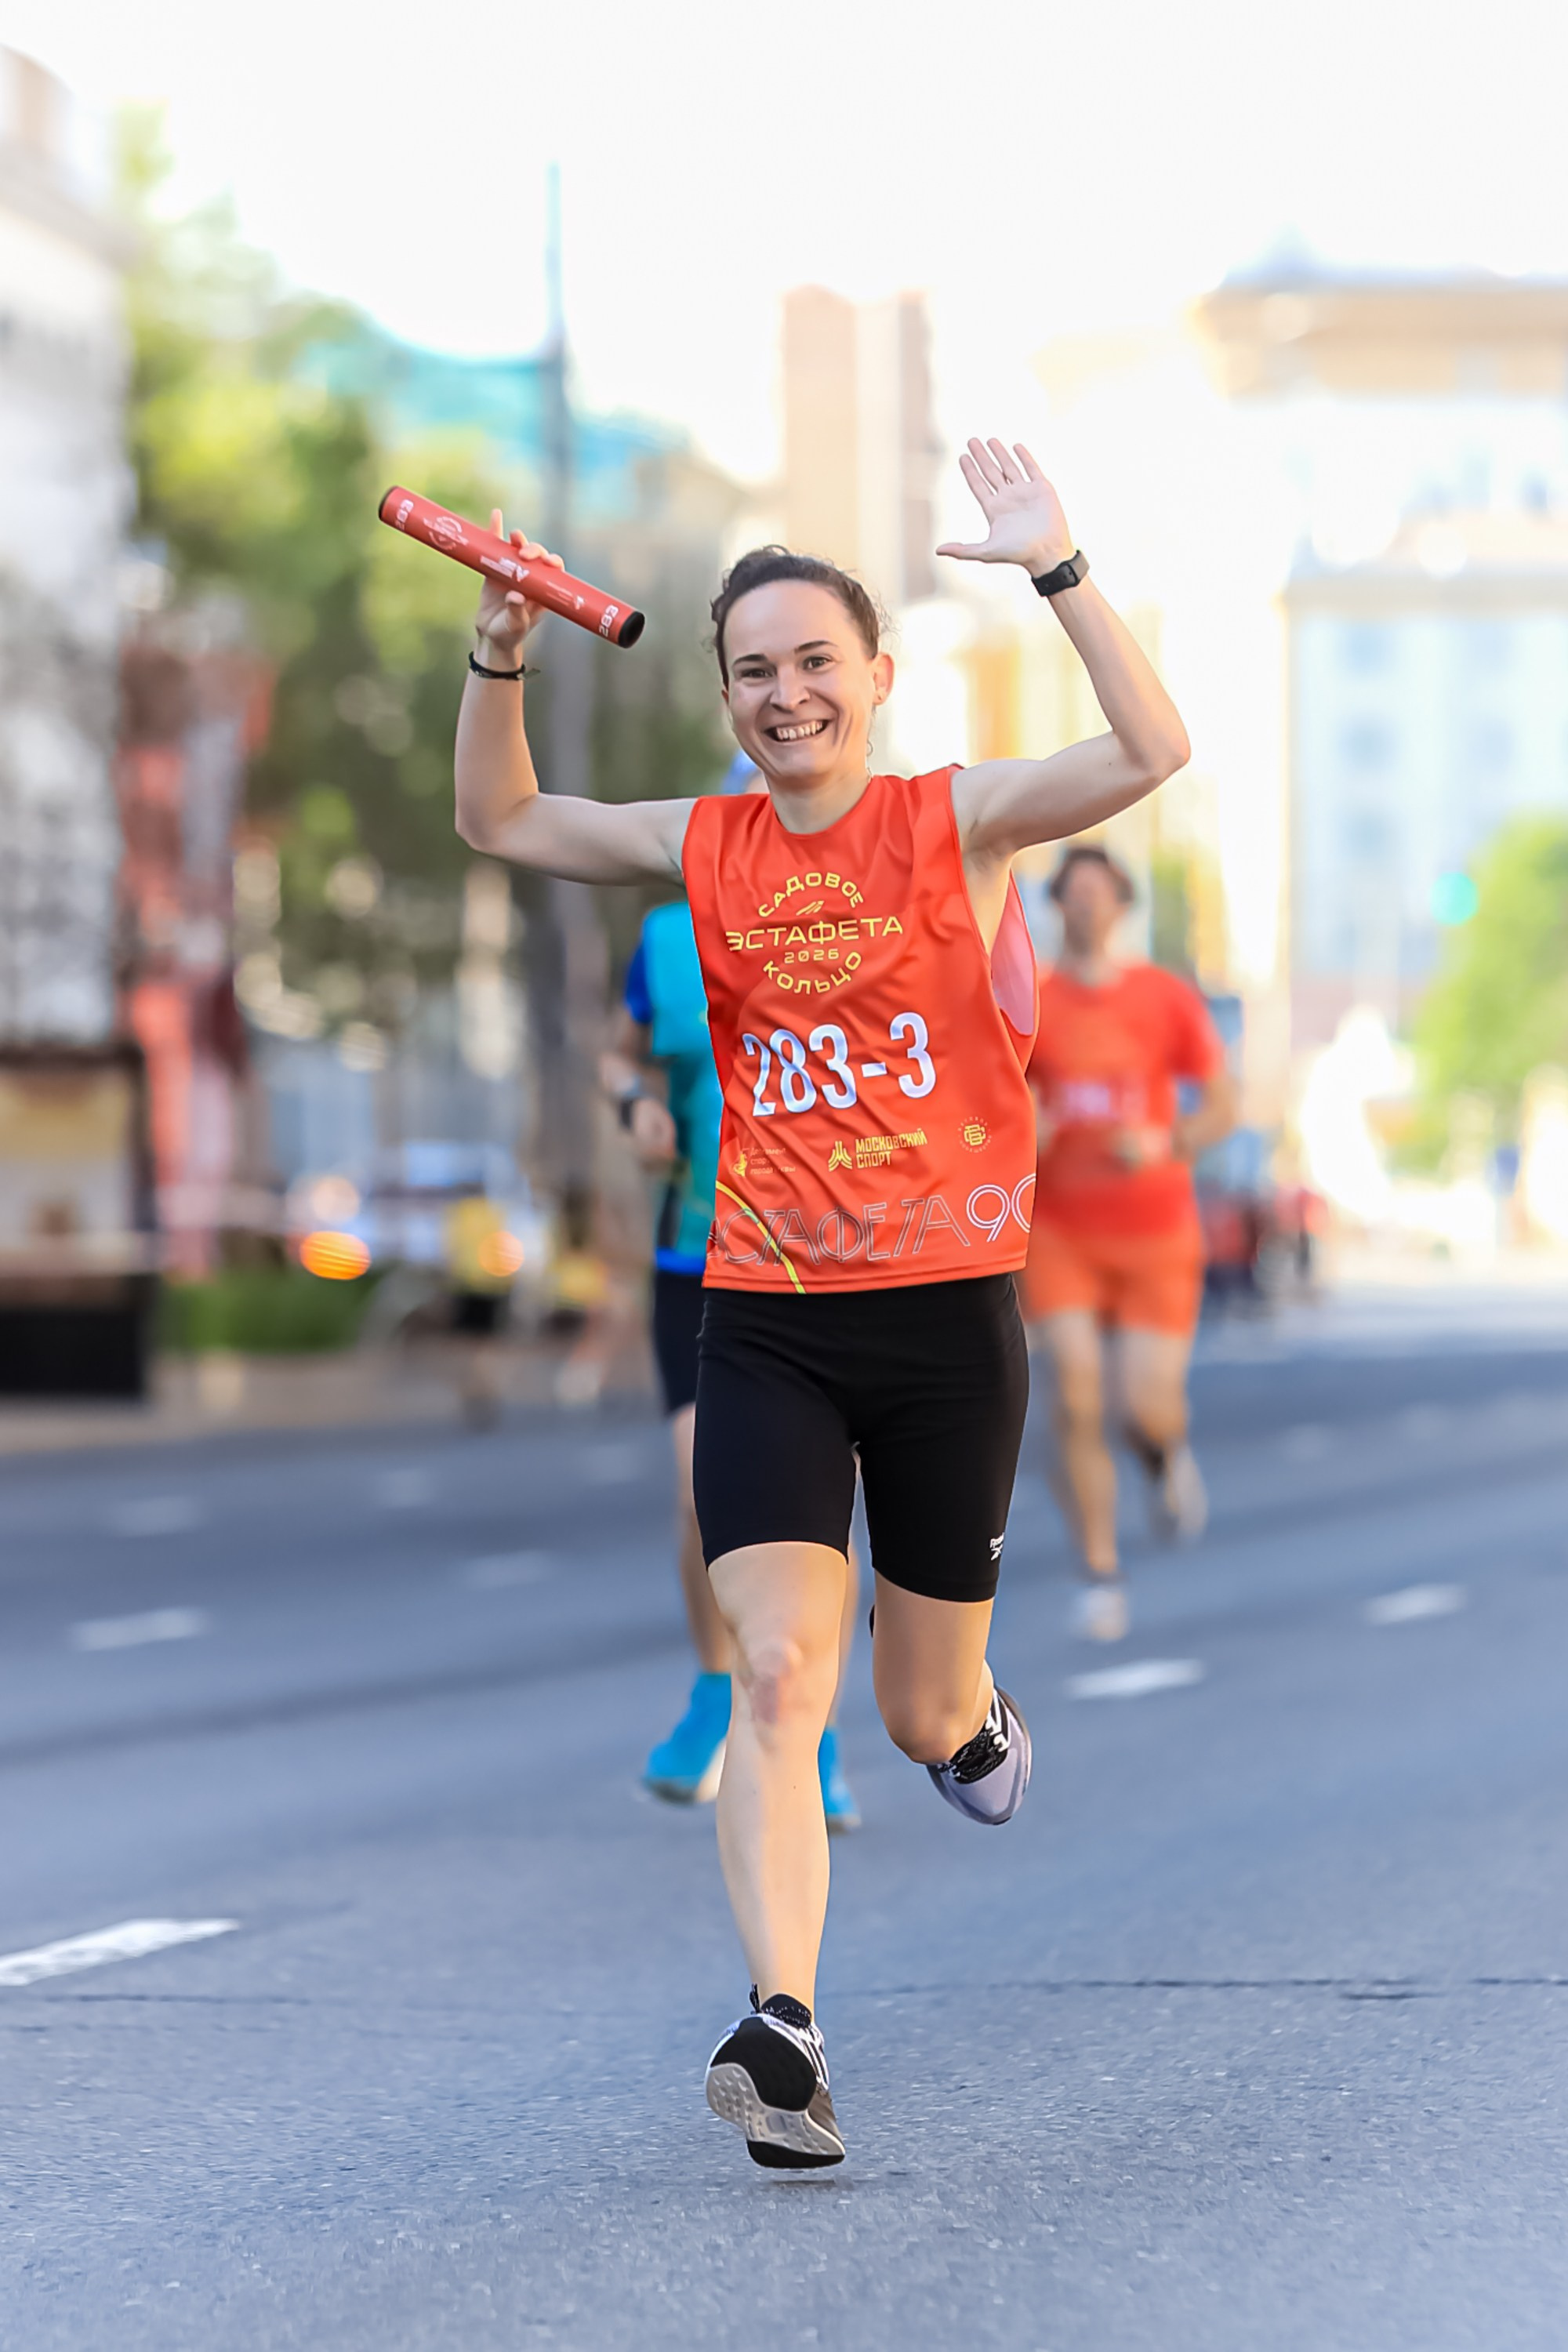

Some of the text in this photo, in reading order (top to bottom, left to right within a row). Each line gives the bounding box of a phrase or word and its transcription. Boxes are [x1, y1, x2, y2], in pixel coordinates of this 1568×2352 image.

[598, 604, 619, 637] 283
[758, 872, 864, 917] САДОВОЕ
[725, 916, 903, 951] ЭСТАФЕТА
[763, 951, 862, 995] КОЛЬЦО
[784, 948, 839, 964] 2026
[742, 1011, 937, 1116] 283-3
[855, 1127, 927, 1153] МОСКОВСКИЙ
[856, 1150, 891, 1169] СПОРТ
